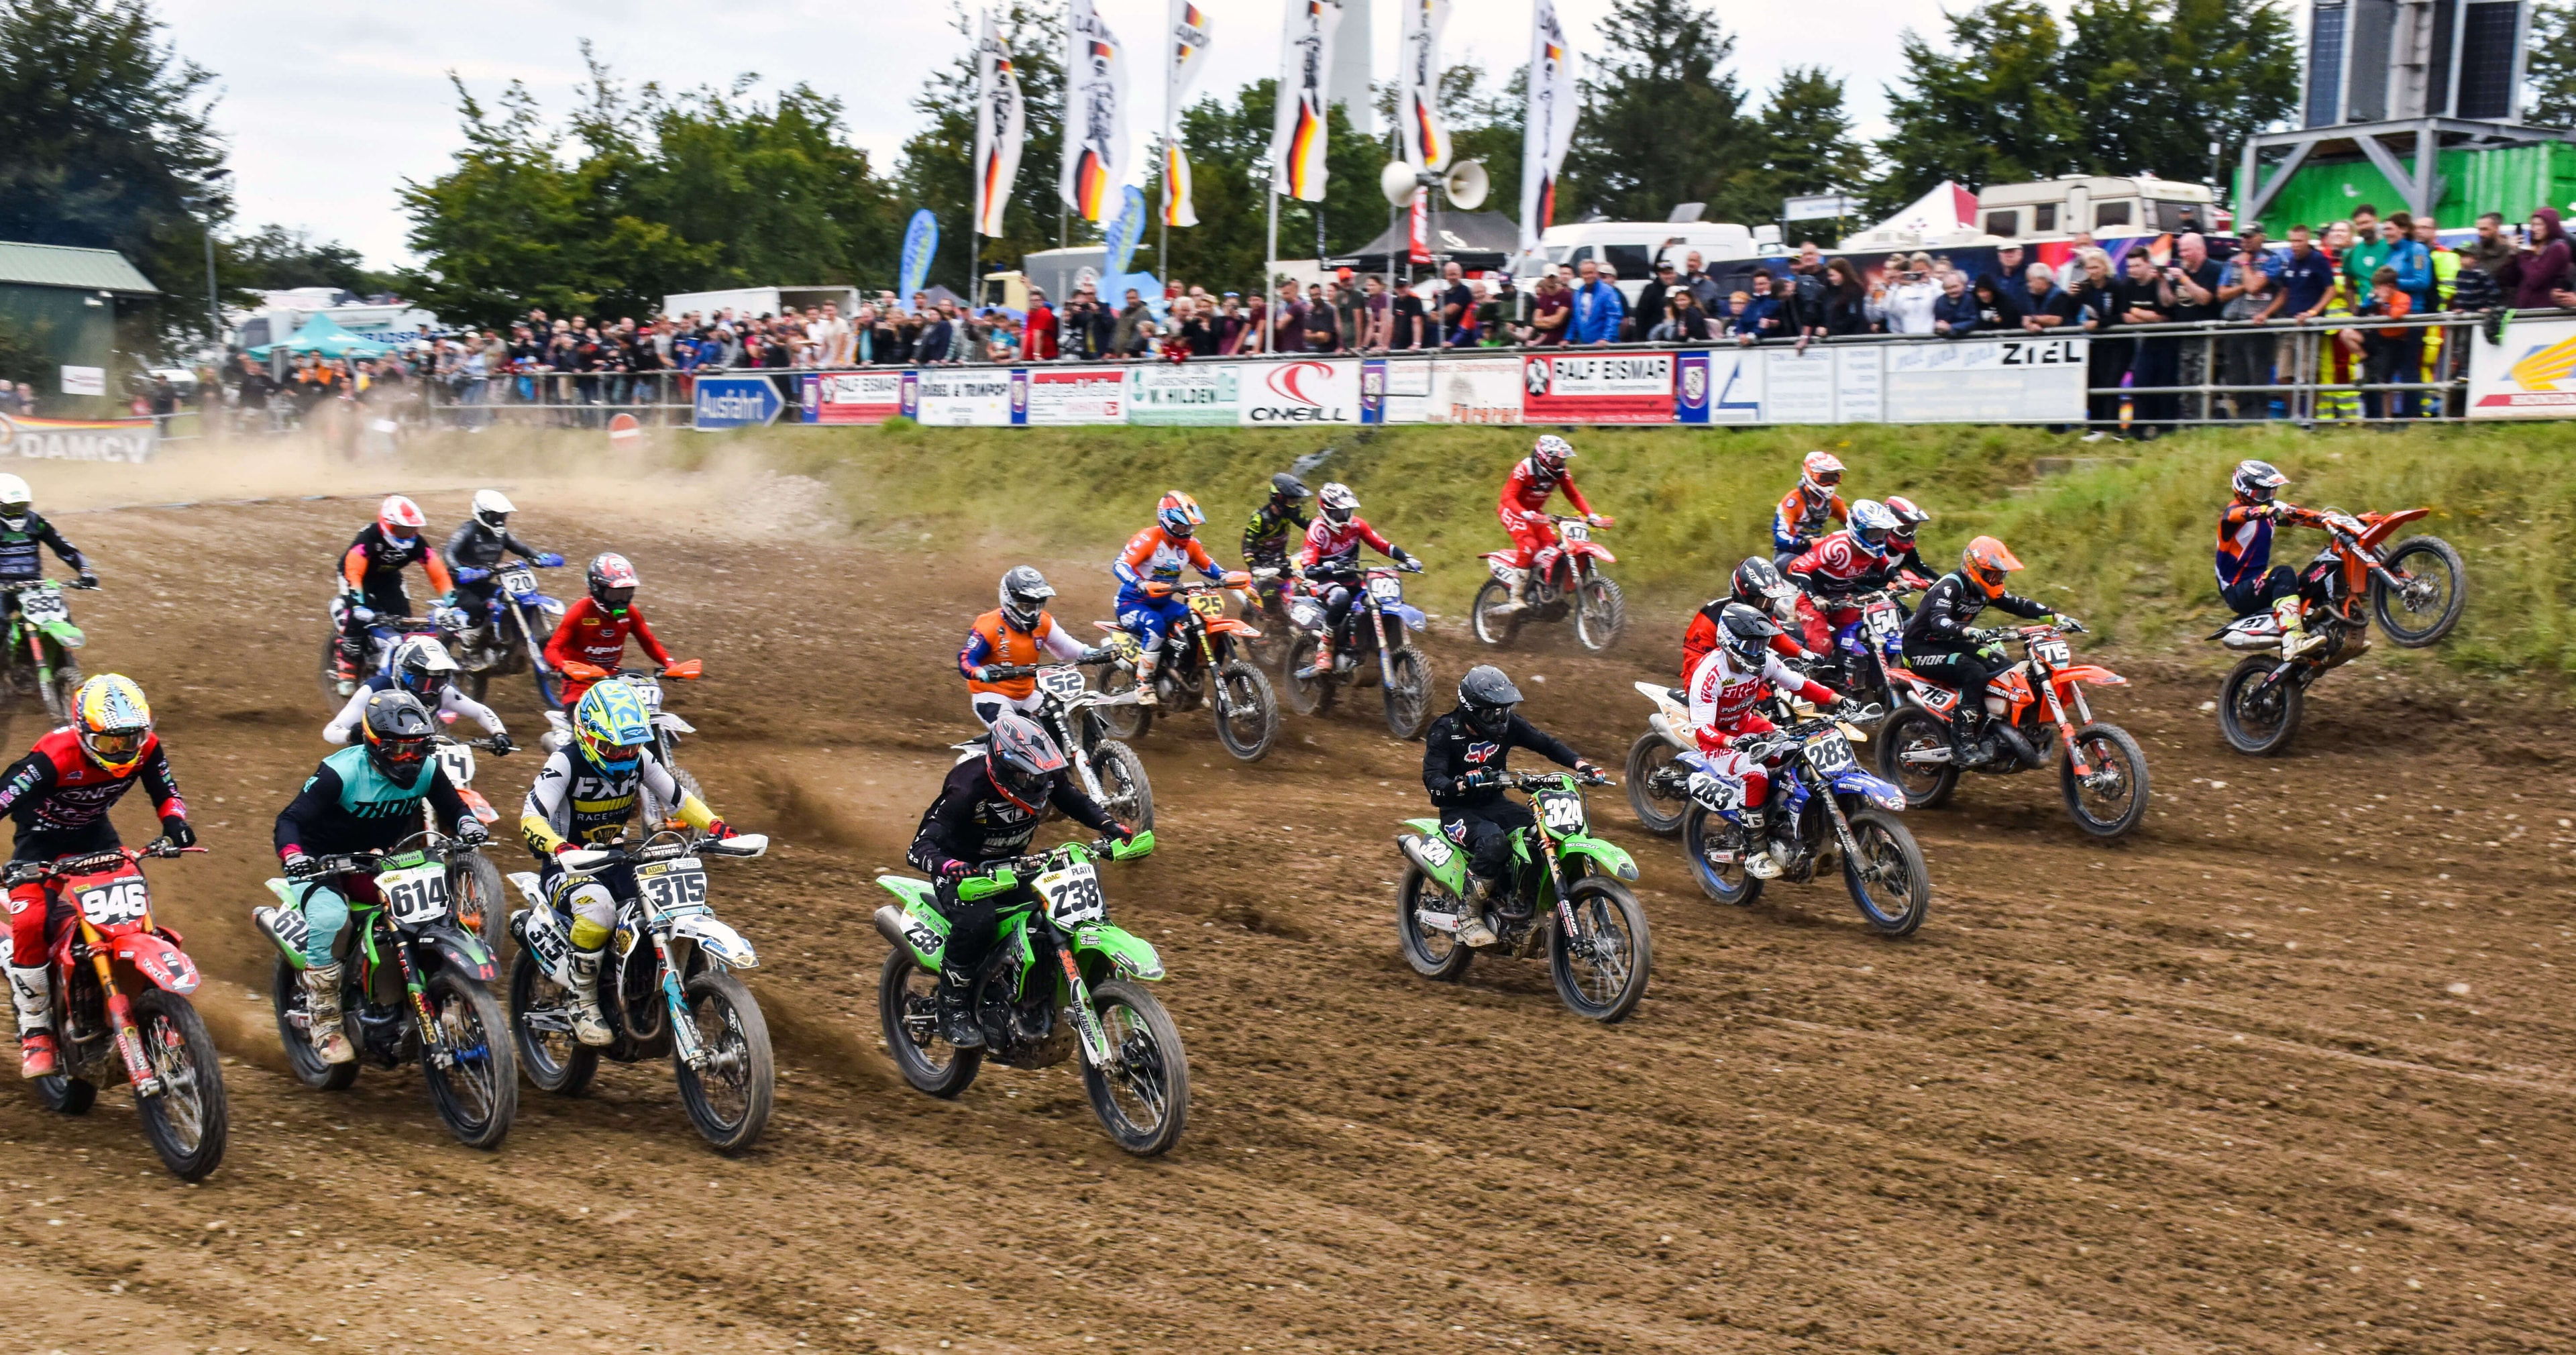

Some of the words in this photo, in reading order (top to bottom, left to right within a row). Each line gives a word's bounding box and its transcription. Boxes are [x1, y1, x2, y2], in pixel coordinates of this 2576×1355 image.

[2002, 341, 2083, 365] ZIEL
[1554, 360, 1595, 380] RALF
[1605, 359, 1668, 380] EISMAR
[698, 388, 765, 420] Ausfahrt
[511, 576, 533, 591] 20
[1198, 597, 1222, 616] 25
[1872, 608, 1899, 635] 54
[1121, 637, 1141, 660] 25
[1911, 655, 1947, 666] THOR
[2037, 641, 2070, 662] 715
[1046, 673, 1082, 694] 52
[1921, 685, 1950, 706] 715
[1809, 737, 1851, 770] 283
[1690, 777, 1735, 811] 283
[578, 812, 607, 822] RACE
[1544, 798, 1584, 828] 324
[1419, 838, 1454, 867] 324
[382, 875, 401, 885] ADAC
[647, 865, 667, 875] ADAC
[1042, 873, 1061, 885] ADAC
[1071, 867, 1093, 877] PLATT
[390, 876, 450, 918] 614
[647, 873, 706, 907] 315
[1051, 877, 1099, 919] 238
[82, 883, 147, 925] 946
[1563, 899, 1580, 936] DUNLOP
[273, 910, 310, 954] 614
[904, 921, 943, 957] 238
[1073, 999, 1096, 1044] DW-RACING
